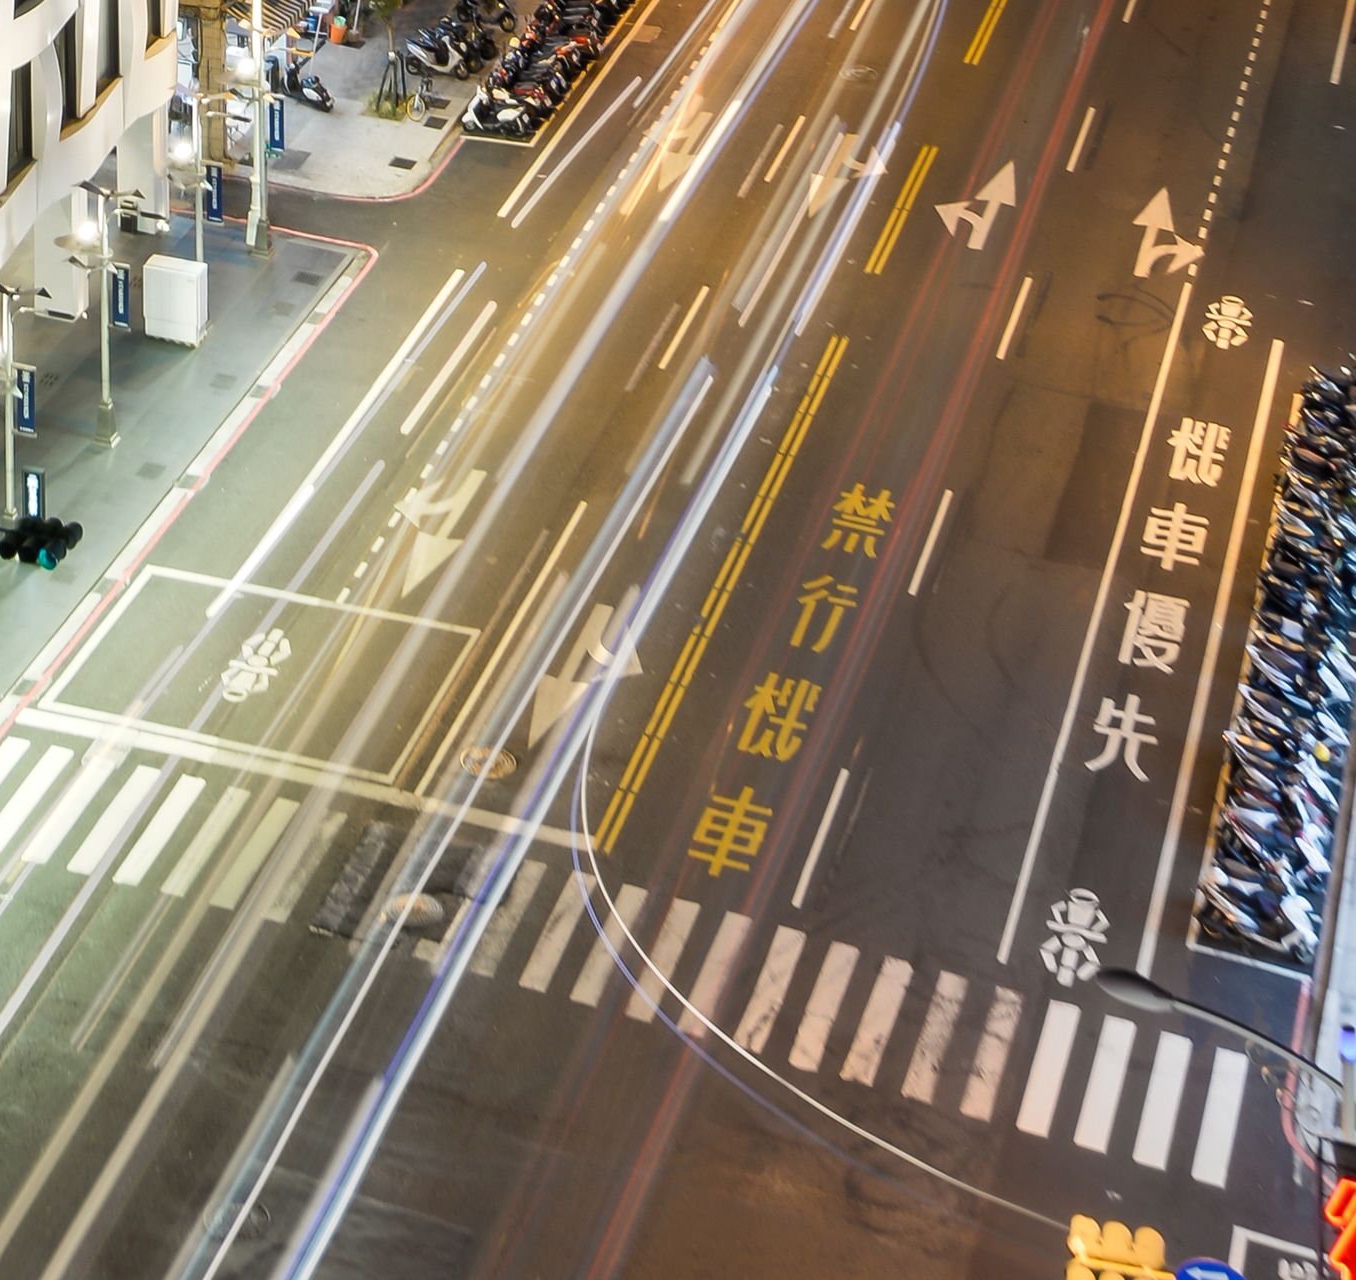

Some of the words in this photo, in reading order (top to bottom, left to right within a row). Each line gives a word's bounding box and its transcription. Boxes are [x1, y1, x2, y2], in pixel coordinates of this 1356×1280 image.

[687, 482, 895, 877] 禁行機車
[1085, 417, 1232, 782] 機車優先
